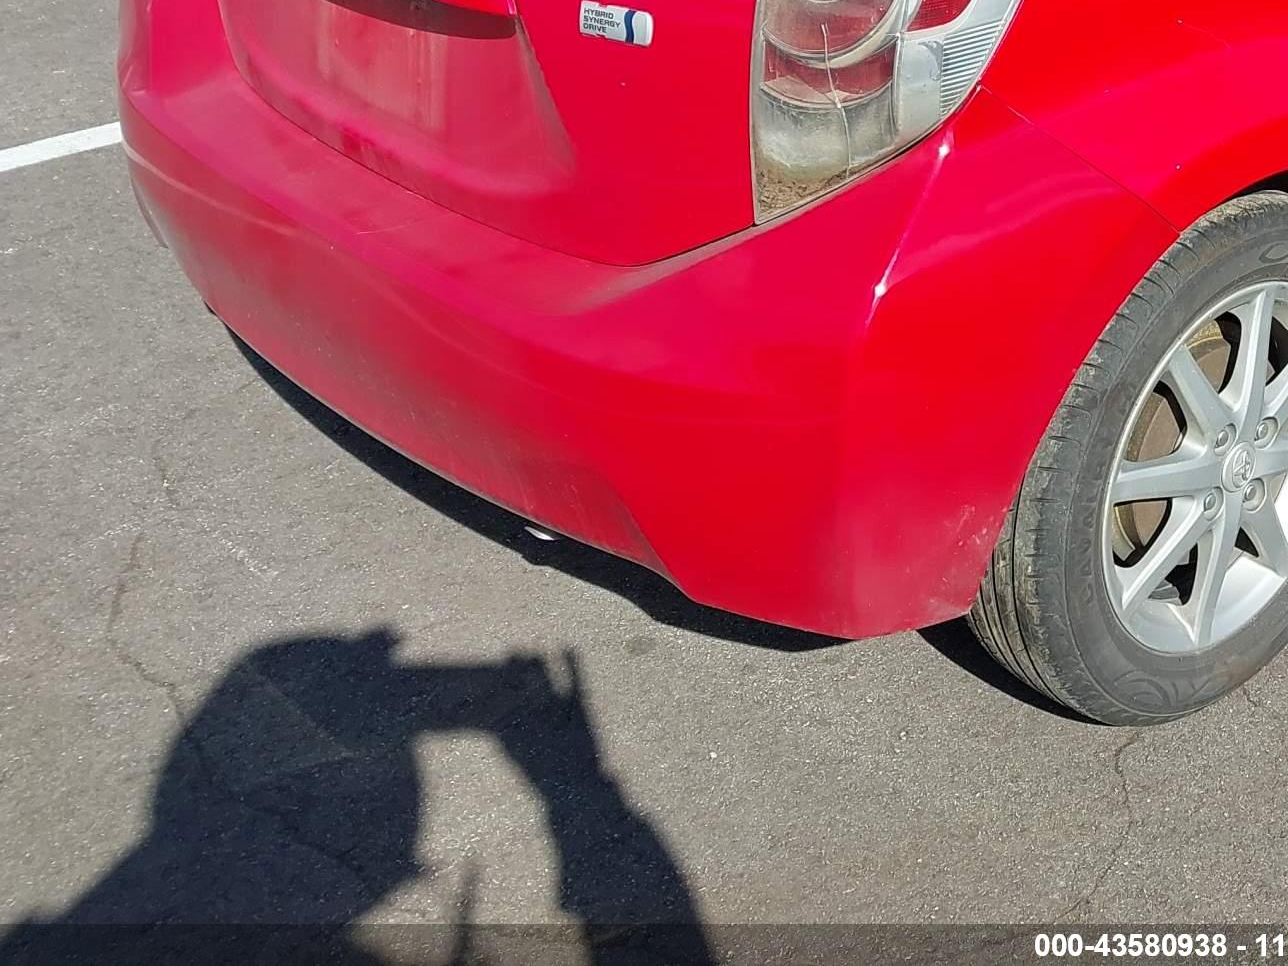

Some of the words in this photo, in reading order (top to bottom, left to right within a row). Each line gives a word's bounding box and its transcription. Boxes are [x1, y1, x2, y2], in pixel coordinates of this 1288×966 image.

[583, 7, 614, 20] HYBRID
[582, 22, 607, 33] DRIVE
[583, 15, 621, 28] SYNERGY
